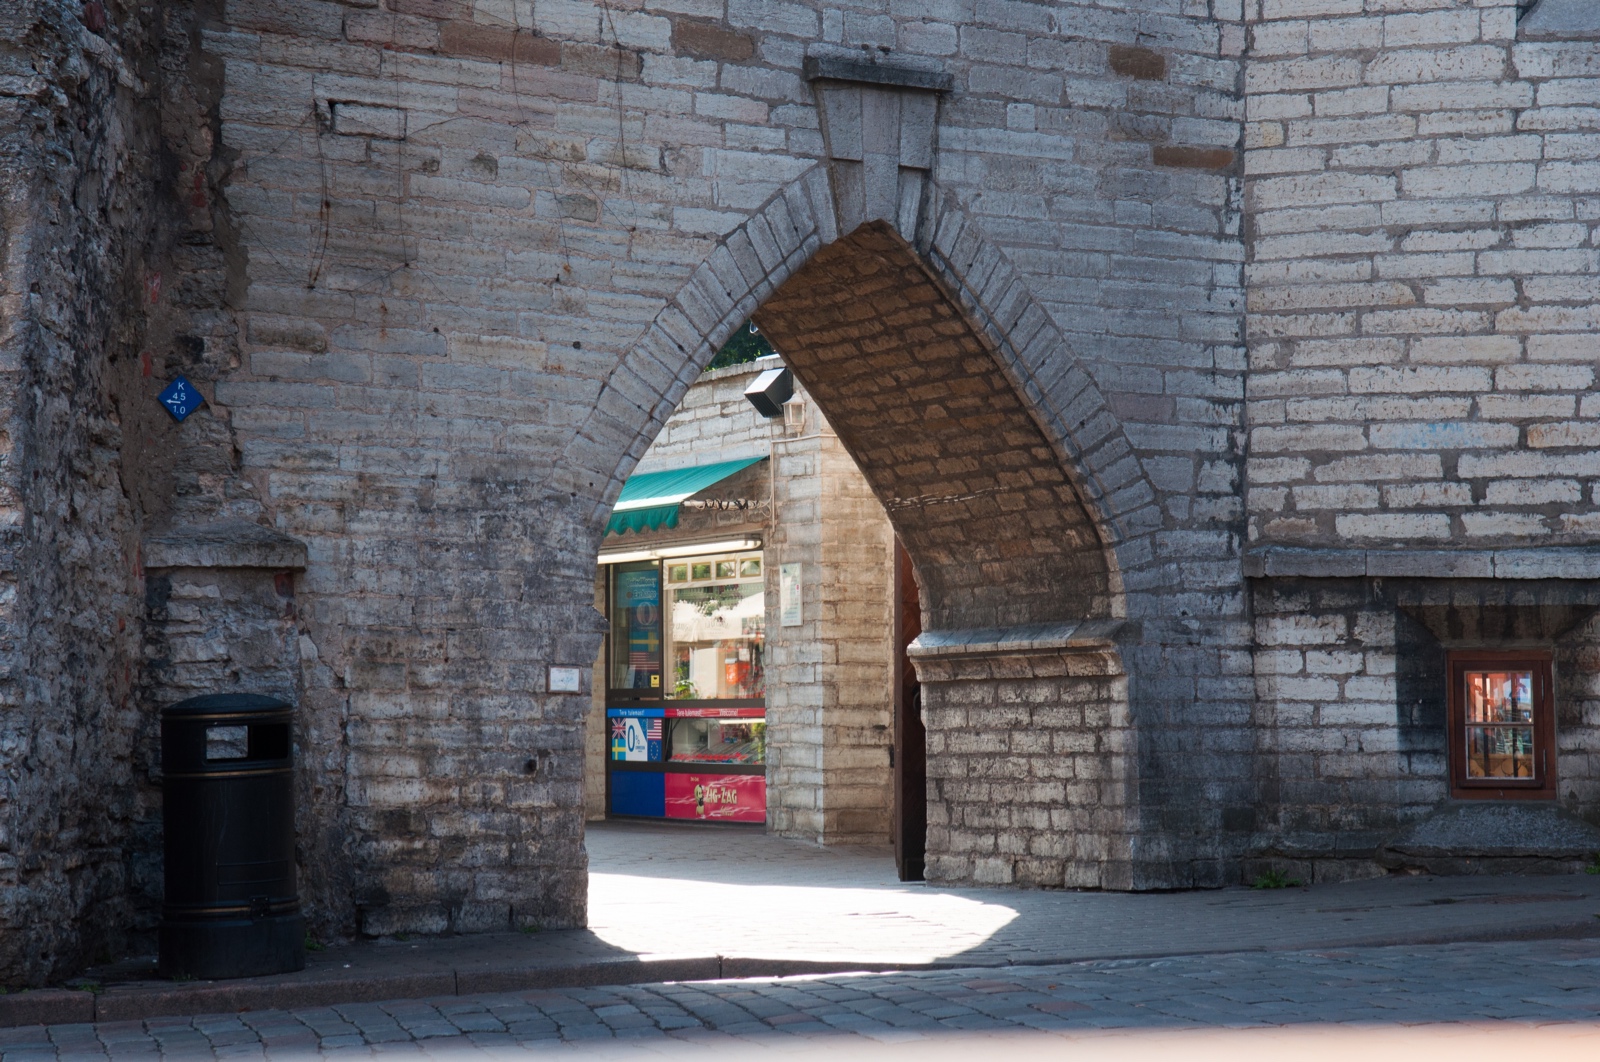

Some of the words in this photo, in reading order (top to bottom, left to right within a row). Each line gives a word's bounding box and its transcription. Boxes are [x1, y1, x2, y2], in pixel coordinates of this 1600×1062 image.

[178, 382, 184, 390] K
[173, 405, 186, 414] 1.0
[705, 786, 738, 804] ZIG-ZAG
